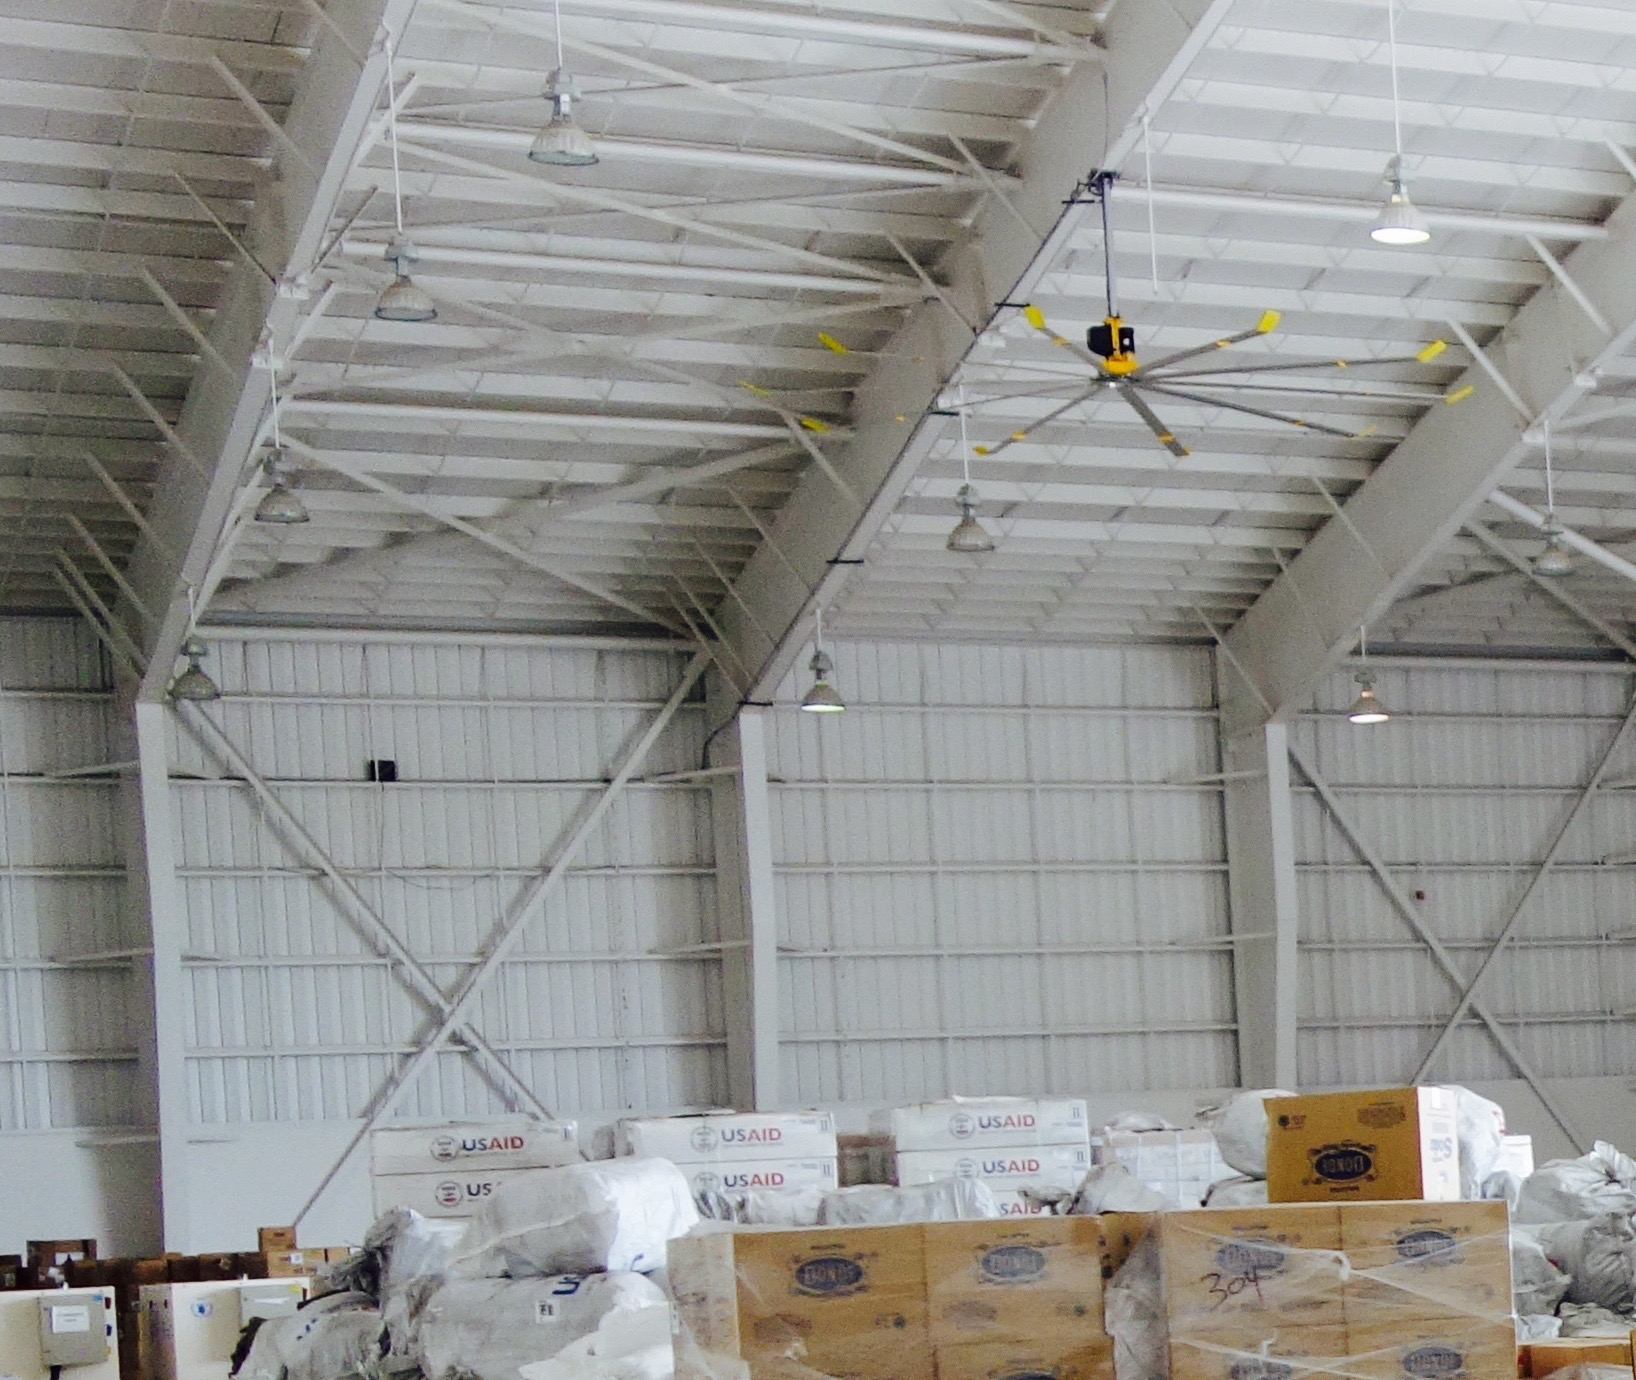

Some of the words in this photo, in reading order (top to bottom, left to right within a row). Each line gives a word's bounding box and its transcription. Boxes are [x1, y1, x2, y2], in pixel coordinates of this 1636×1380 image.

[978, 1114, 1036, 1129] USAID
[721, 1127, 782, 1142] USAID
[461, 1135, 525, 1152] USAID
[982, 1158, 1040, 1174] USAID
[724, 1172, 785, 1188] USAID
